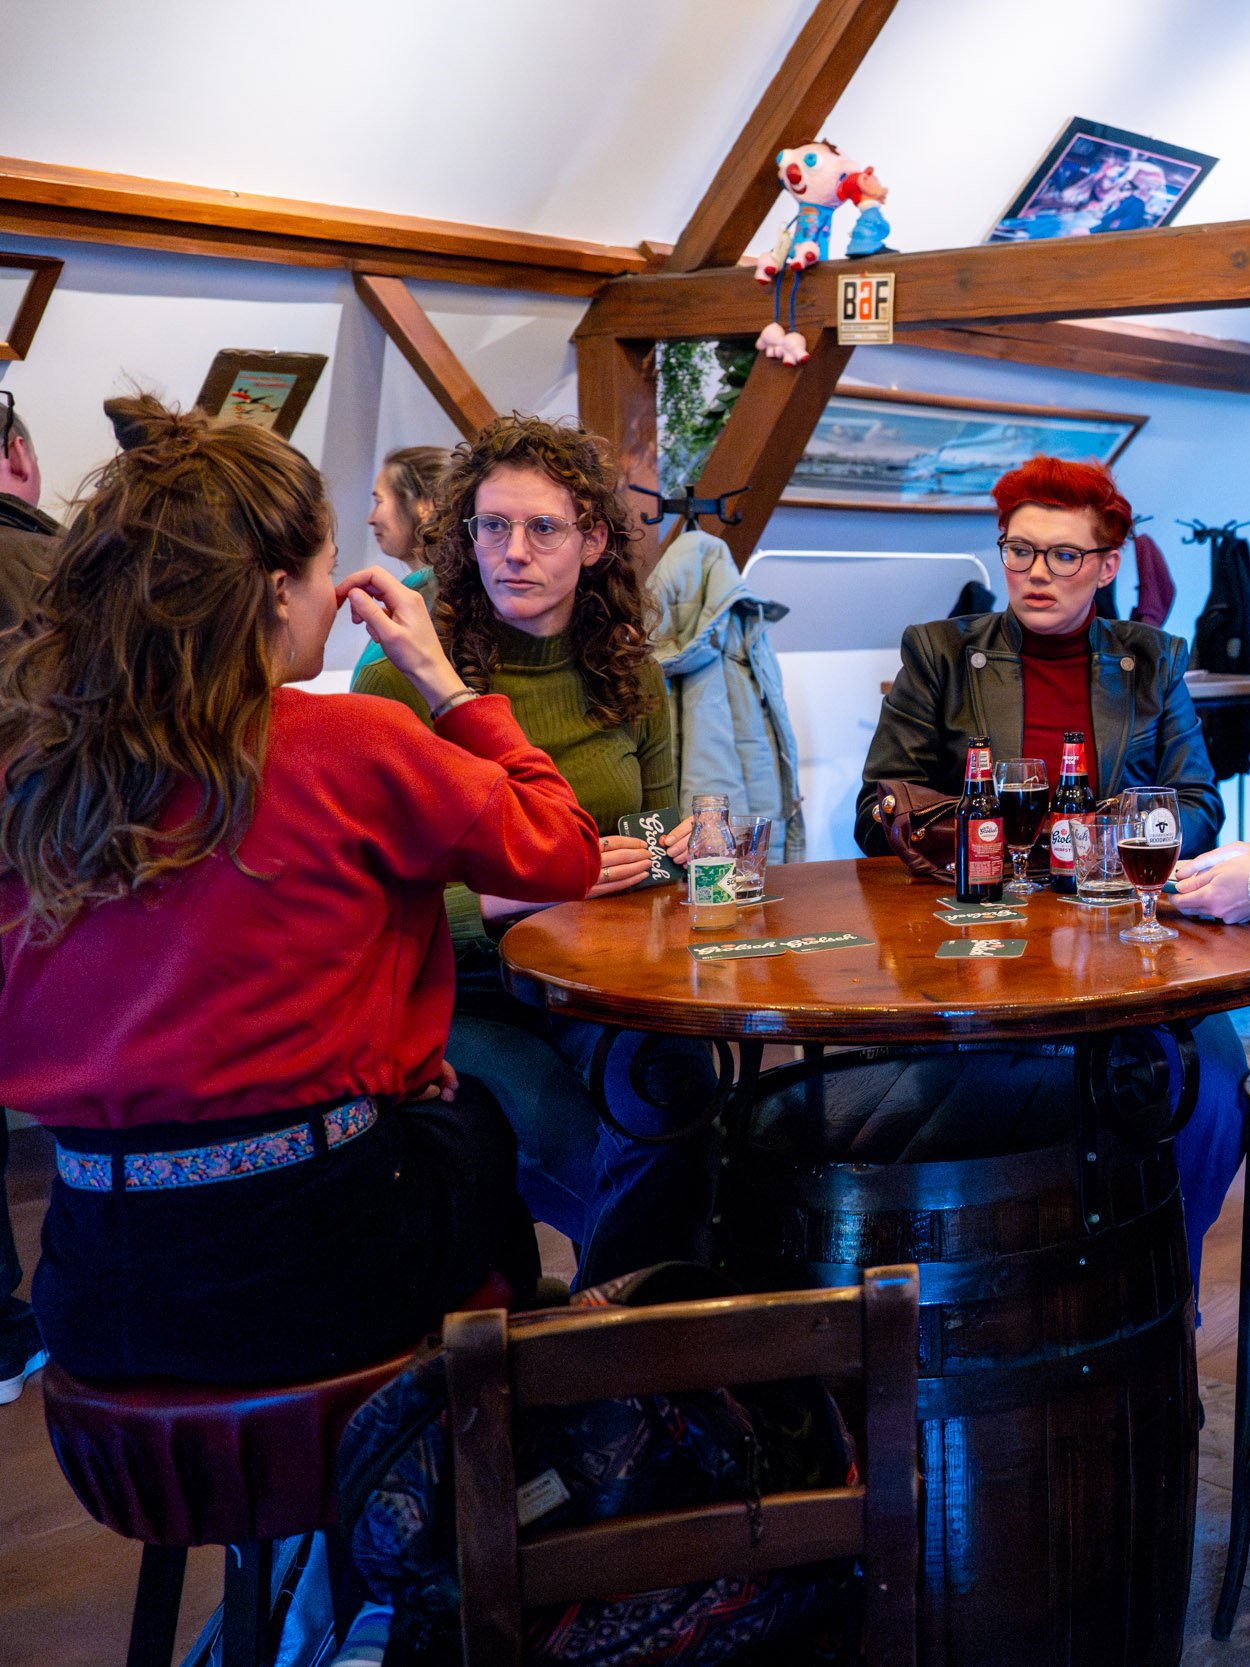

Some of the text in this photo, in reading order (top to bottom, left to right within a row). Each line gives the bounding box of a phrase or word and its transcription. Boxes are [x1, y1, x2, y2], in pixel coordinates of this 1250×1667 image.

[843, 280, 889, 320] BaF
[638, 812, 671, 882] Grolsch
[694, 941, 777, 955] Grolsch
[779, 933, 858, 948] Grolsch
